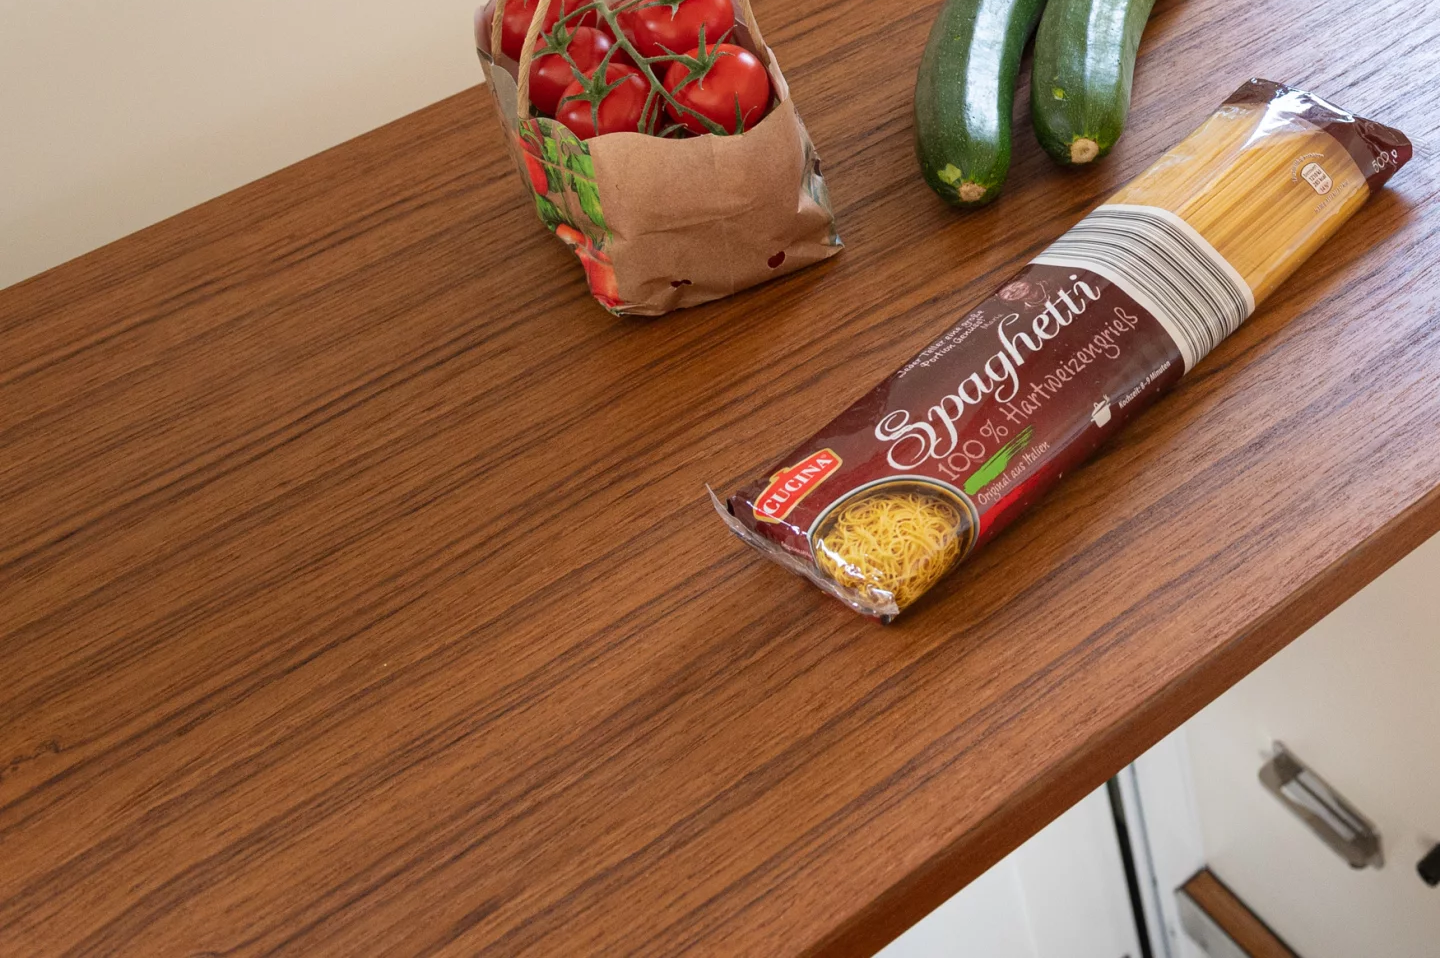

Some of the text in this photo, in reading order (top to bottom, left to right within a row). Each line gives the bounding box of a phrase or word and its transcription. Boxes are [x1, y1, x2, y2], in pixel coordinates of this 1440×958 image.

[1371, 151, 1390, 174] 500
[874, 273, 1102, 471] Spaghetti
[937, 306, 1139, 482] 100 % Hartweizengrieß
[1119, 385, 1142, 409] Kochzeit:
[1149, 360, 1171, 383] Minuten
[762, 455, 834, 516] CUCINA
[977, 441, 1051, 506] Original aus Italien
